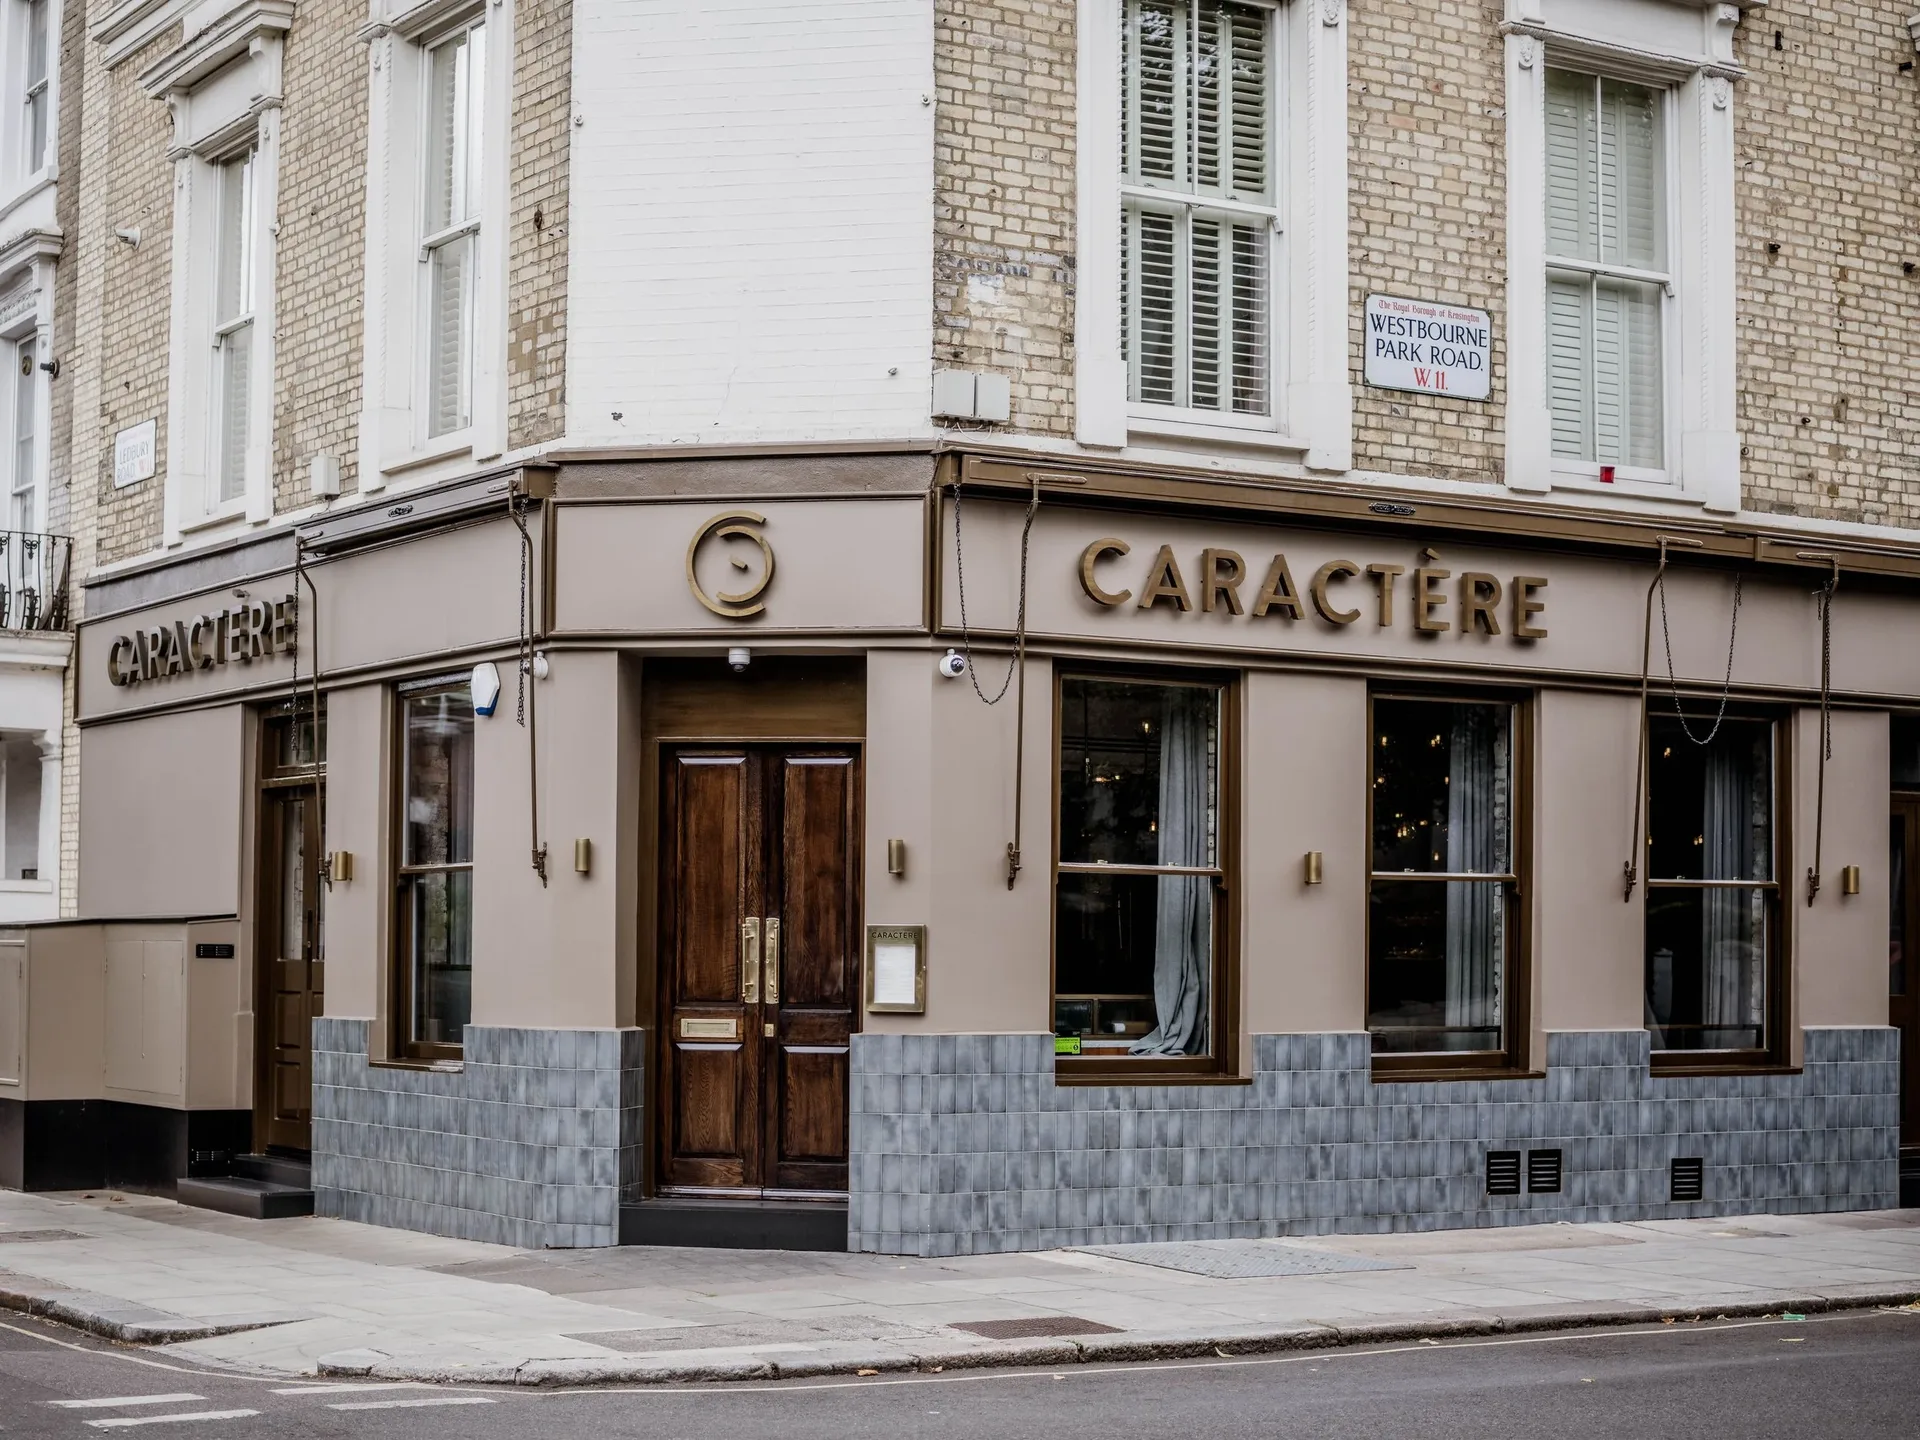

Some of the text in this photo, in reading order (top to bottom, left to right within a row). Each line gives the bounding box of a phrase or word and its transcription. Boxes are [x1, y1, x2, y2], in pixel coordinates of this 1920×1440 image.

[1378, 299, 1480, 324] The Royal Borough of Kensington
[1370, 313, 1487, 348] WESTBOURNE
[1376, 338, 1423, 363] PARK
[119, 440, 149, 465] LEDBURY
[1078, 537, 1548, 639] CARACTÈRE
[108, 589, 294, 686] CARACTÈRE
